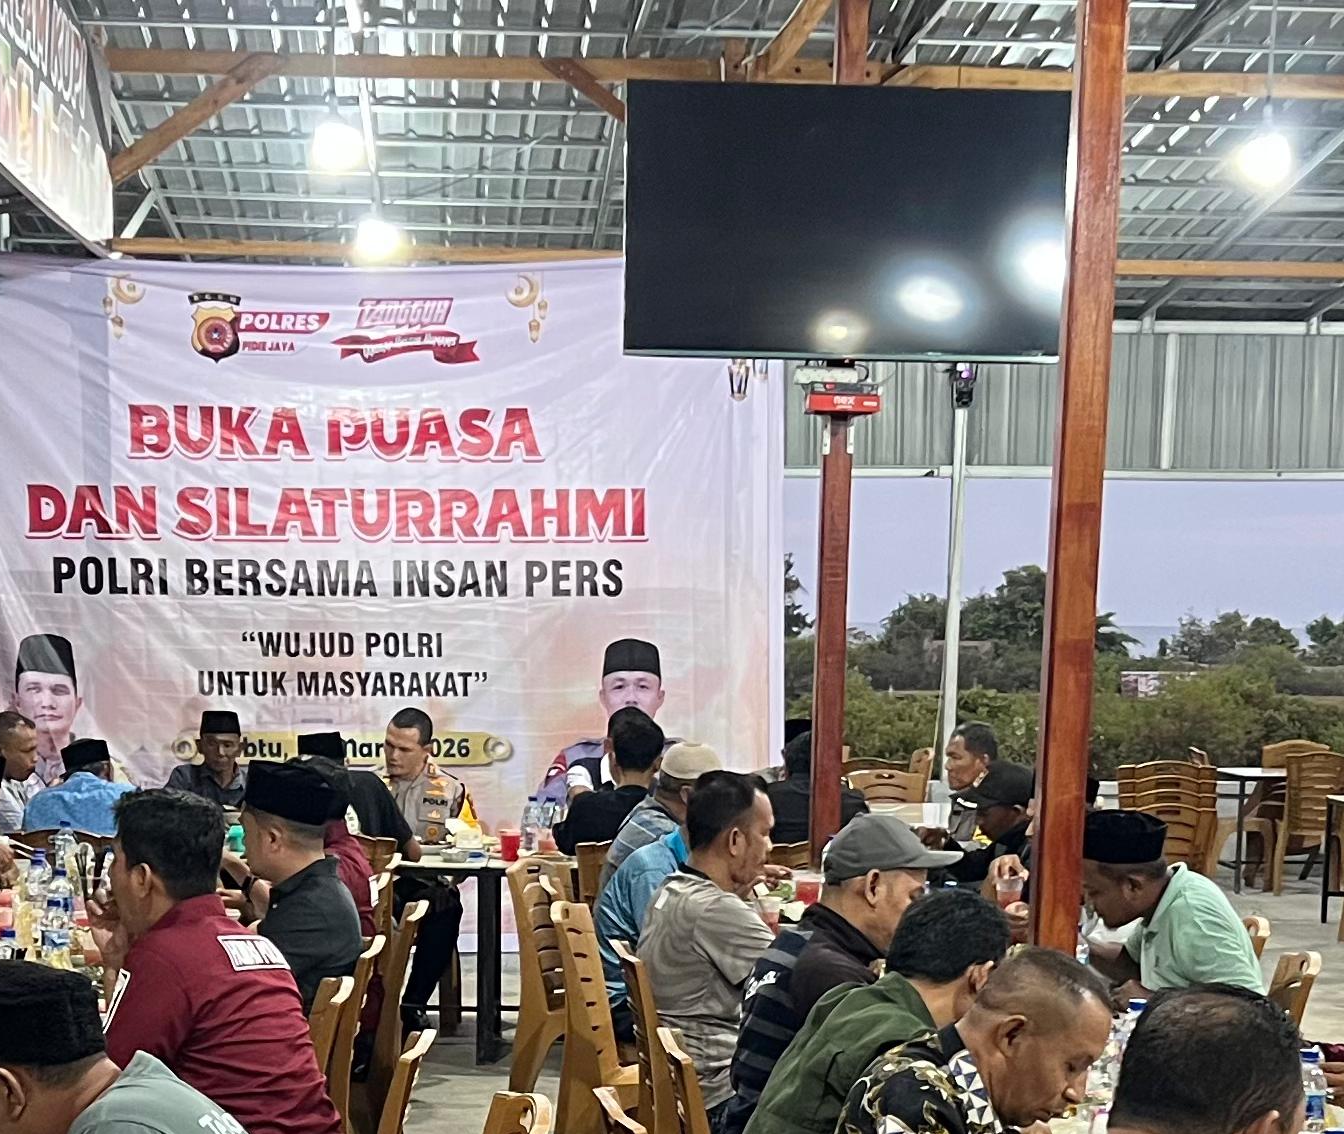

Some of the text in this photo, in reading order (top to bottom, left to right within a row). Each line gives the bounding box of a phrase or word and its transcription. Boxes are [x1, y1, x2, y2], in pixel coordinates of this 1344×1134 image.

[239, 313, 320, 331] POLRES
[242, 341, 295, 352] PIDIE JAYA
[128, 404, 544, 461] BUKA PUASA
[25, 484, 649, 543] DAN SILATURRAHMI
[52, 556, 624, 599] POLRI BERSAMA INSAN PERS
[365, 632, 443, 658] POLRI
[197, 671, 289, 698] UNTUK
[243, 737, 288, 759] btu,
[431, 738, 470, 758] 026
[423, 797, 449, 807] POLRI
